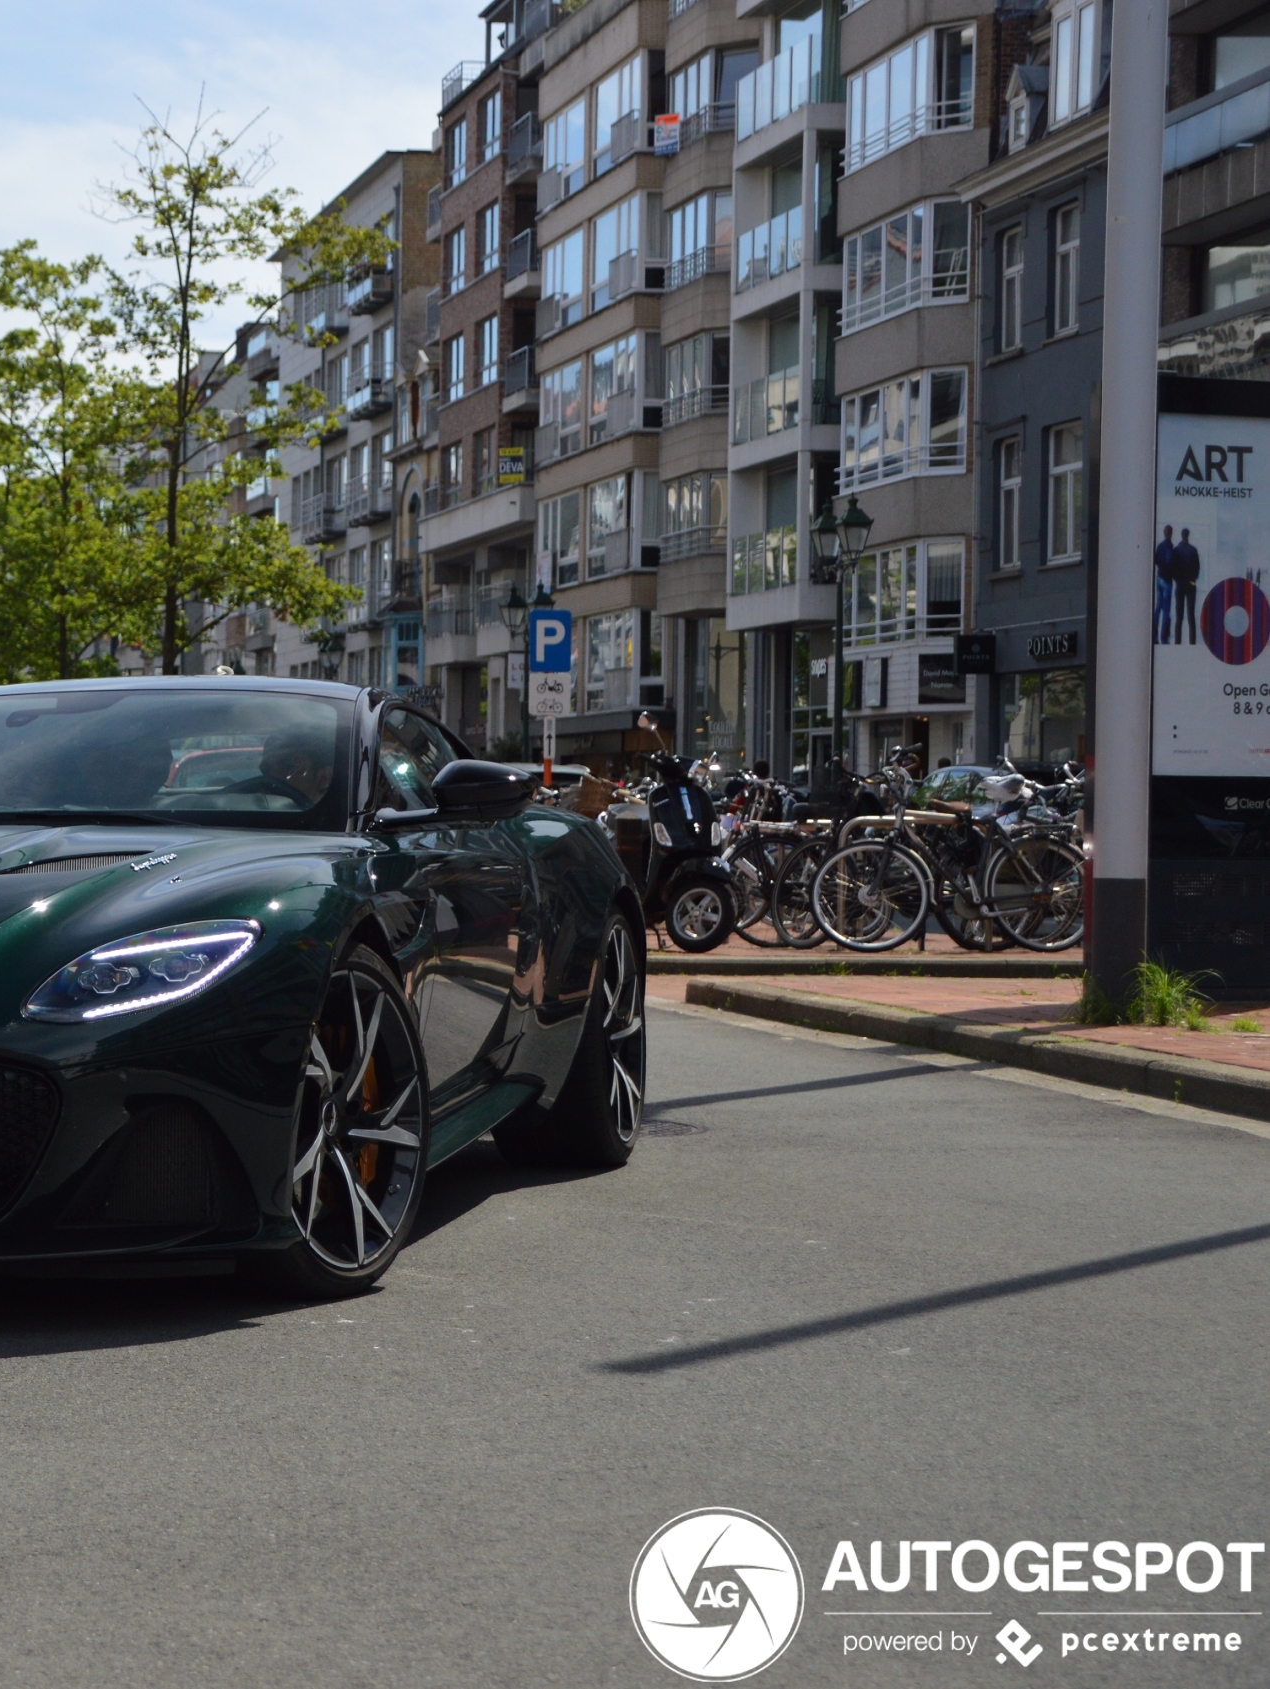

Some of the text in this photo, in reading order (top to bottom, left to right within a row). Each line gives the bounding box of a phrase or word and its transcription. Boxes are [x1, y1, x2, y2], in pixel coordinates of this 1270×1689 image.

[499, 461, 524, 473] DEVA
[1175, 444, 1253, 483] ART
[1174, 485, 1253, 499] KNOKKE-HEIST
[535, 619, 566, 663] P
[1027, 634, 1069, 657] POINTS
[961, 653, 990, 661] POINTS
[923, 669, 941, 677] David
[1223, 682, 1257, 700] Open
[1233, 701, 1241, 715] 8
[1243, 701, 1253, 715] &
[1255, 701, 1264, 715] 9
[1239, 798, 1265, 809] Clear
